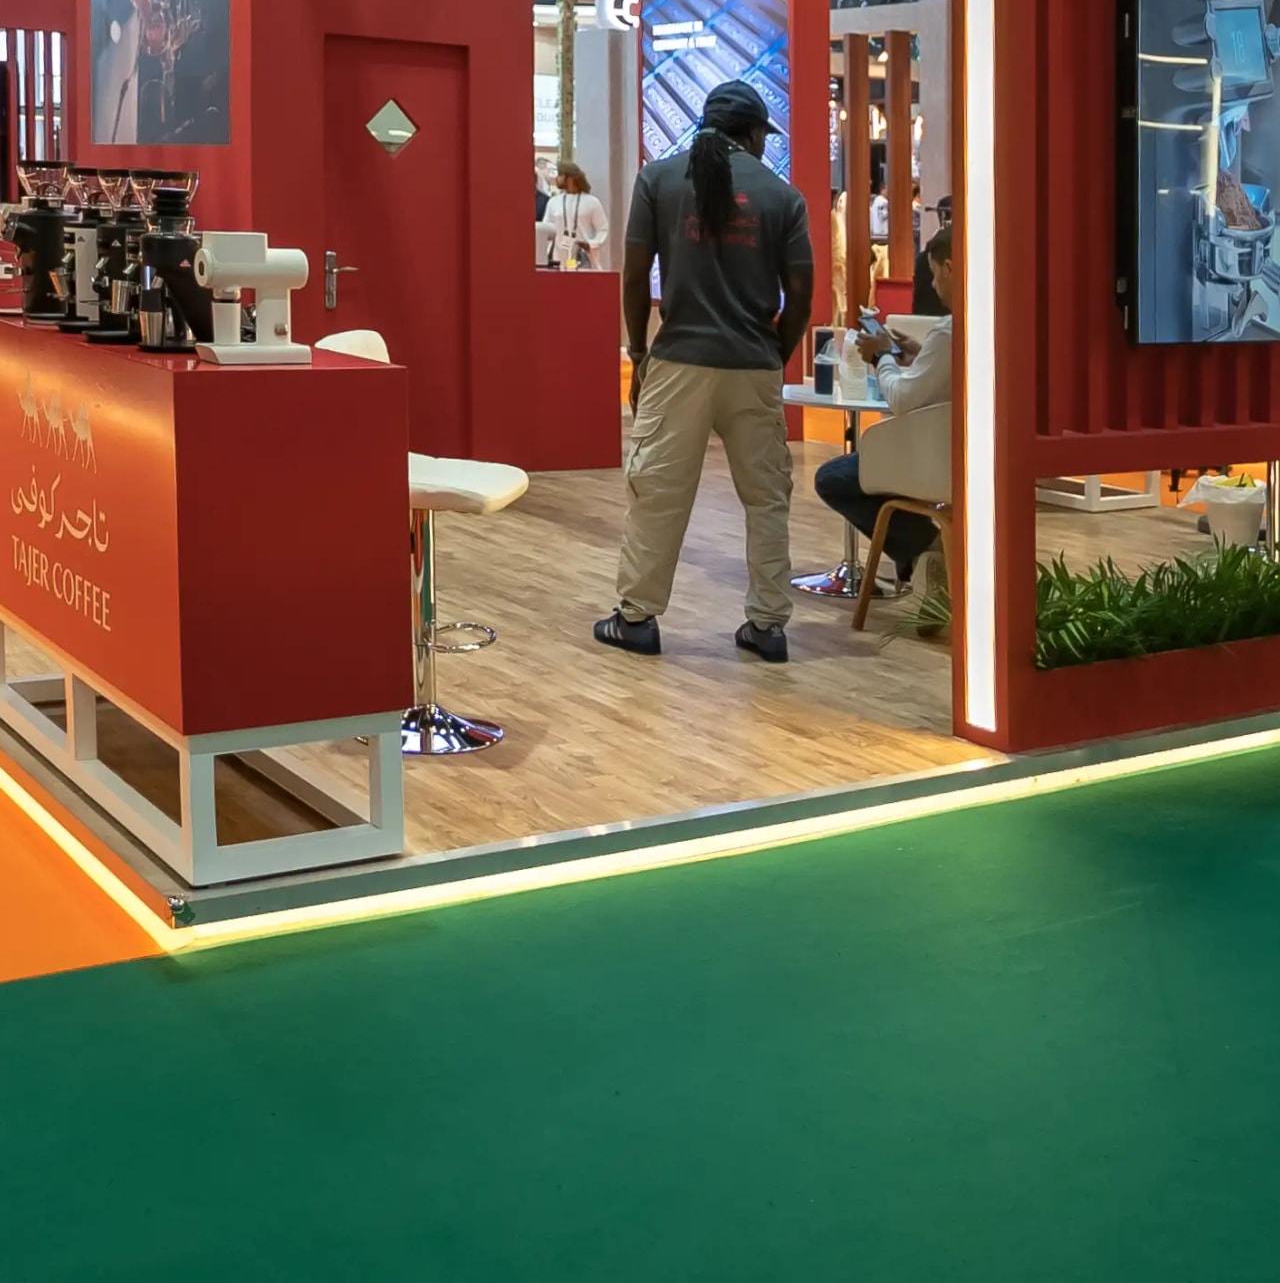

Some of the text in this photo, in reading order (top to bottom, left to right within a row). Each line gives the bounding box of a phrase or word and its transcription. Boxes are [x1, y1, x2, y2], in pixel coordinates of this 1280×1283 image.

[55, 498, 109, 552] تاجر
[11, 534, 111, 632] TAJER COFFEE
